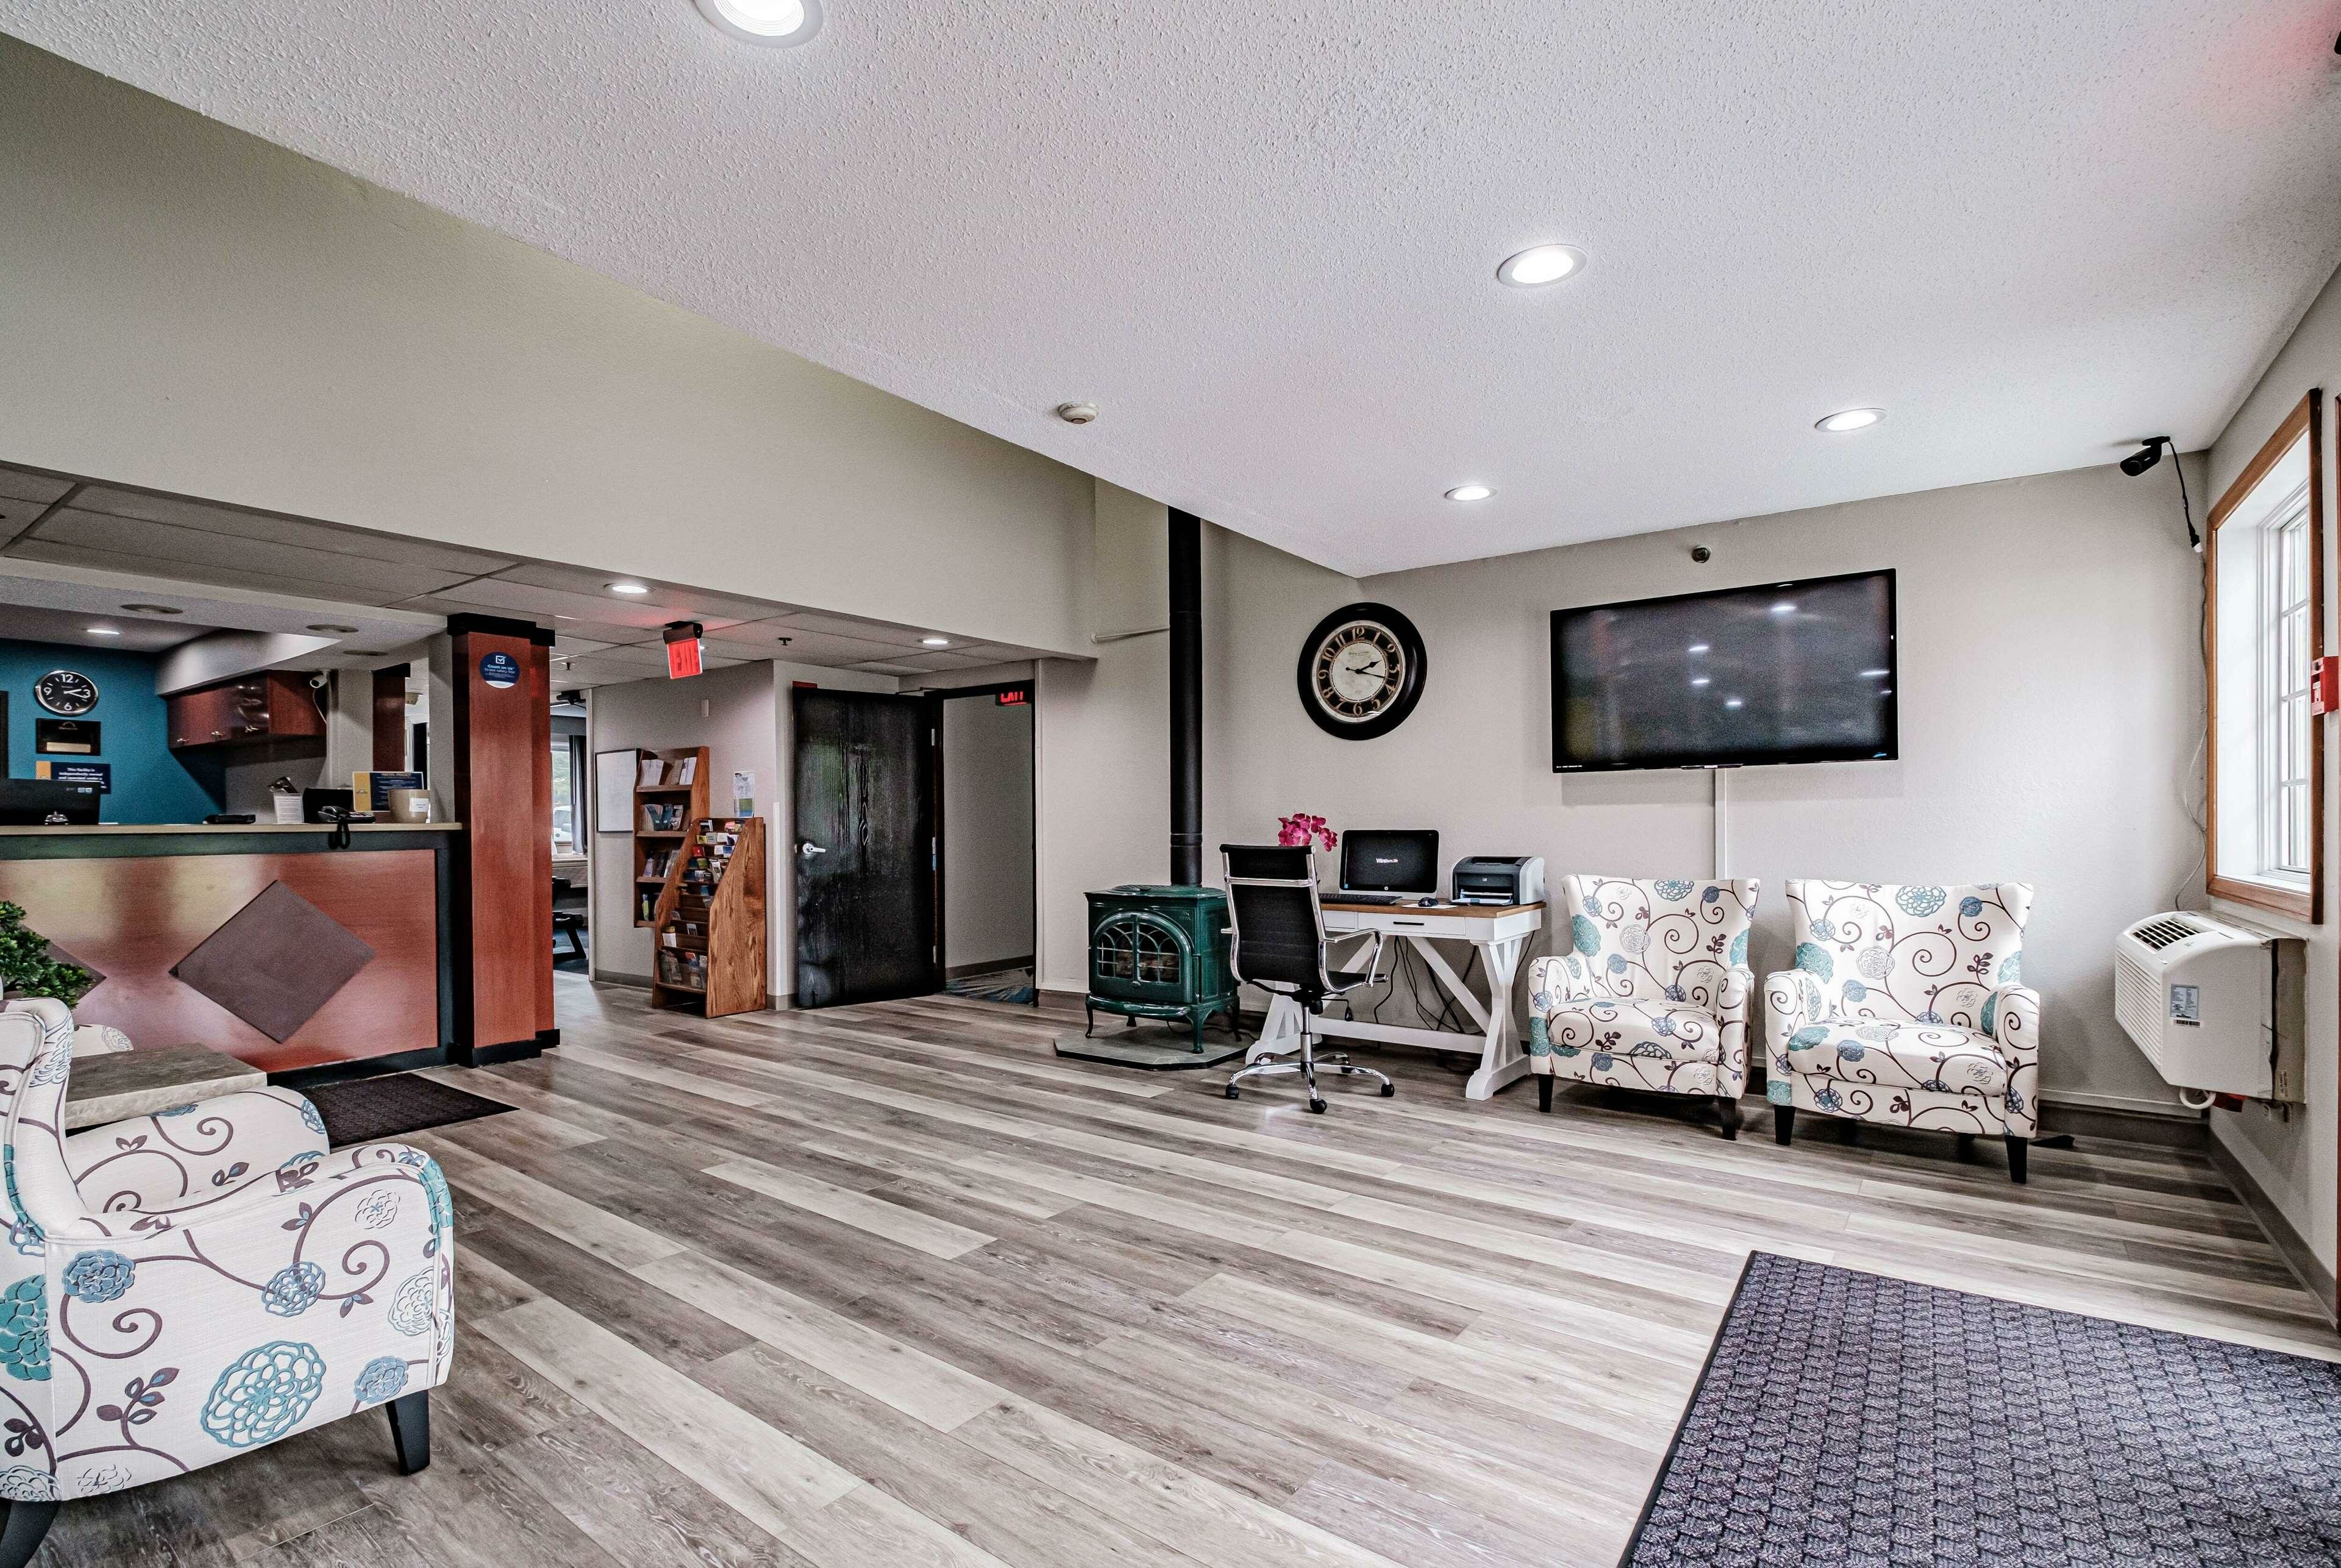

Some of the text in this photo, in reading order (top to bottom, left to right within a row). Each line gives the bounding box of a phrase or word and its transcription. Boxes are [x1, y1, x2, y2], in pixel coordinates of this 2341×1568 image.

[1351, 627, 1365, 640] 12
[1373, 631, 1381, 644] 1
[1335, 633, 1346, 647] 11
[1322, 647, 1336, 662] 10
[61, 674, 73, 683] 12
[1318, 669, 1329, 679] 9
[83, 689, 91, 698] 3
[1322, 686, 1334, 698] 8
[1384, 683, 1395, 695] 4
[1353, 702, 1363, 716] 6
